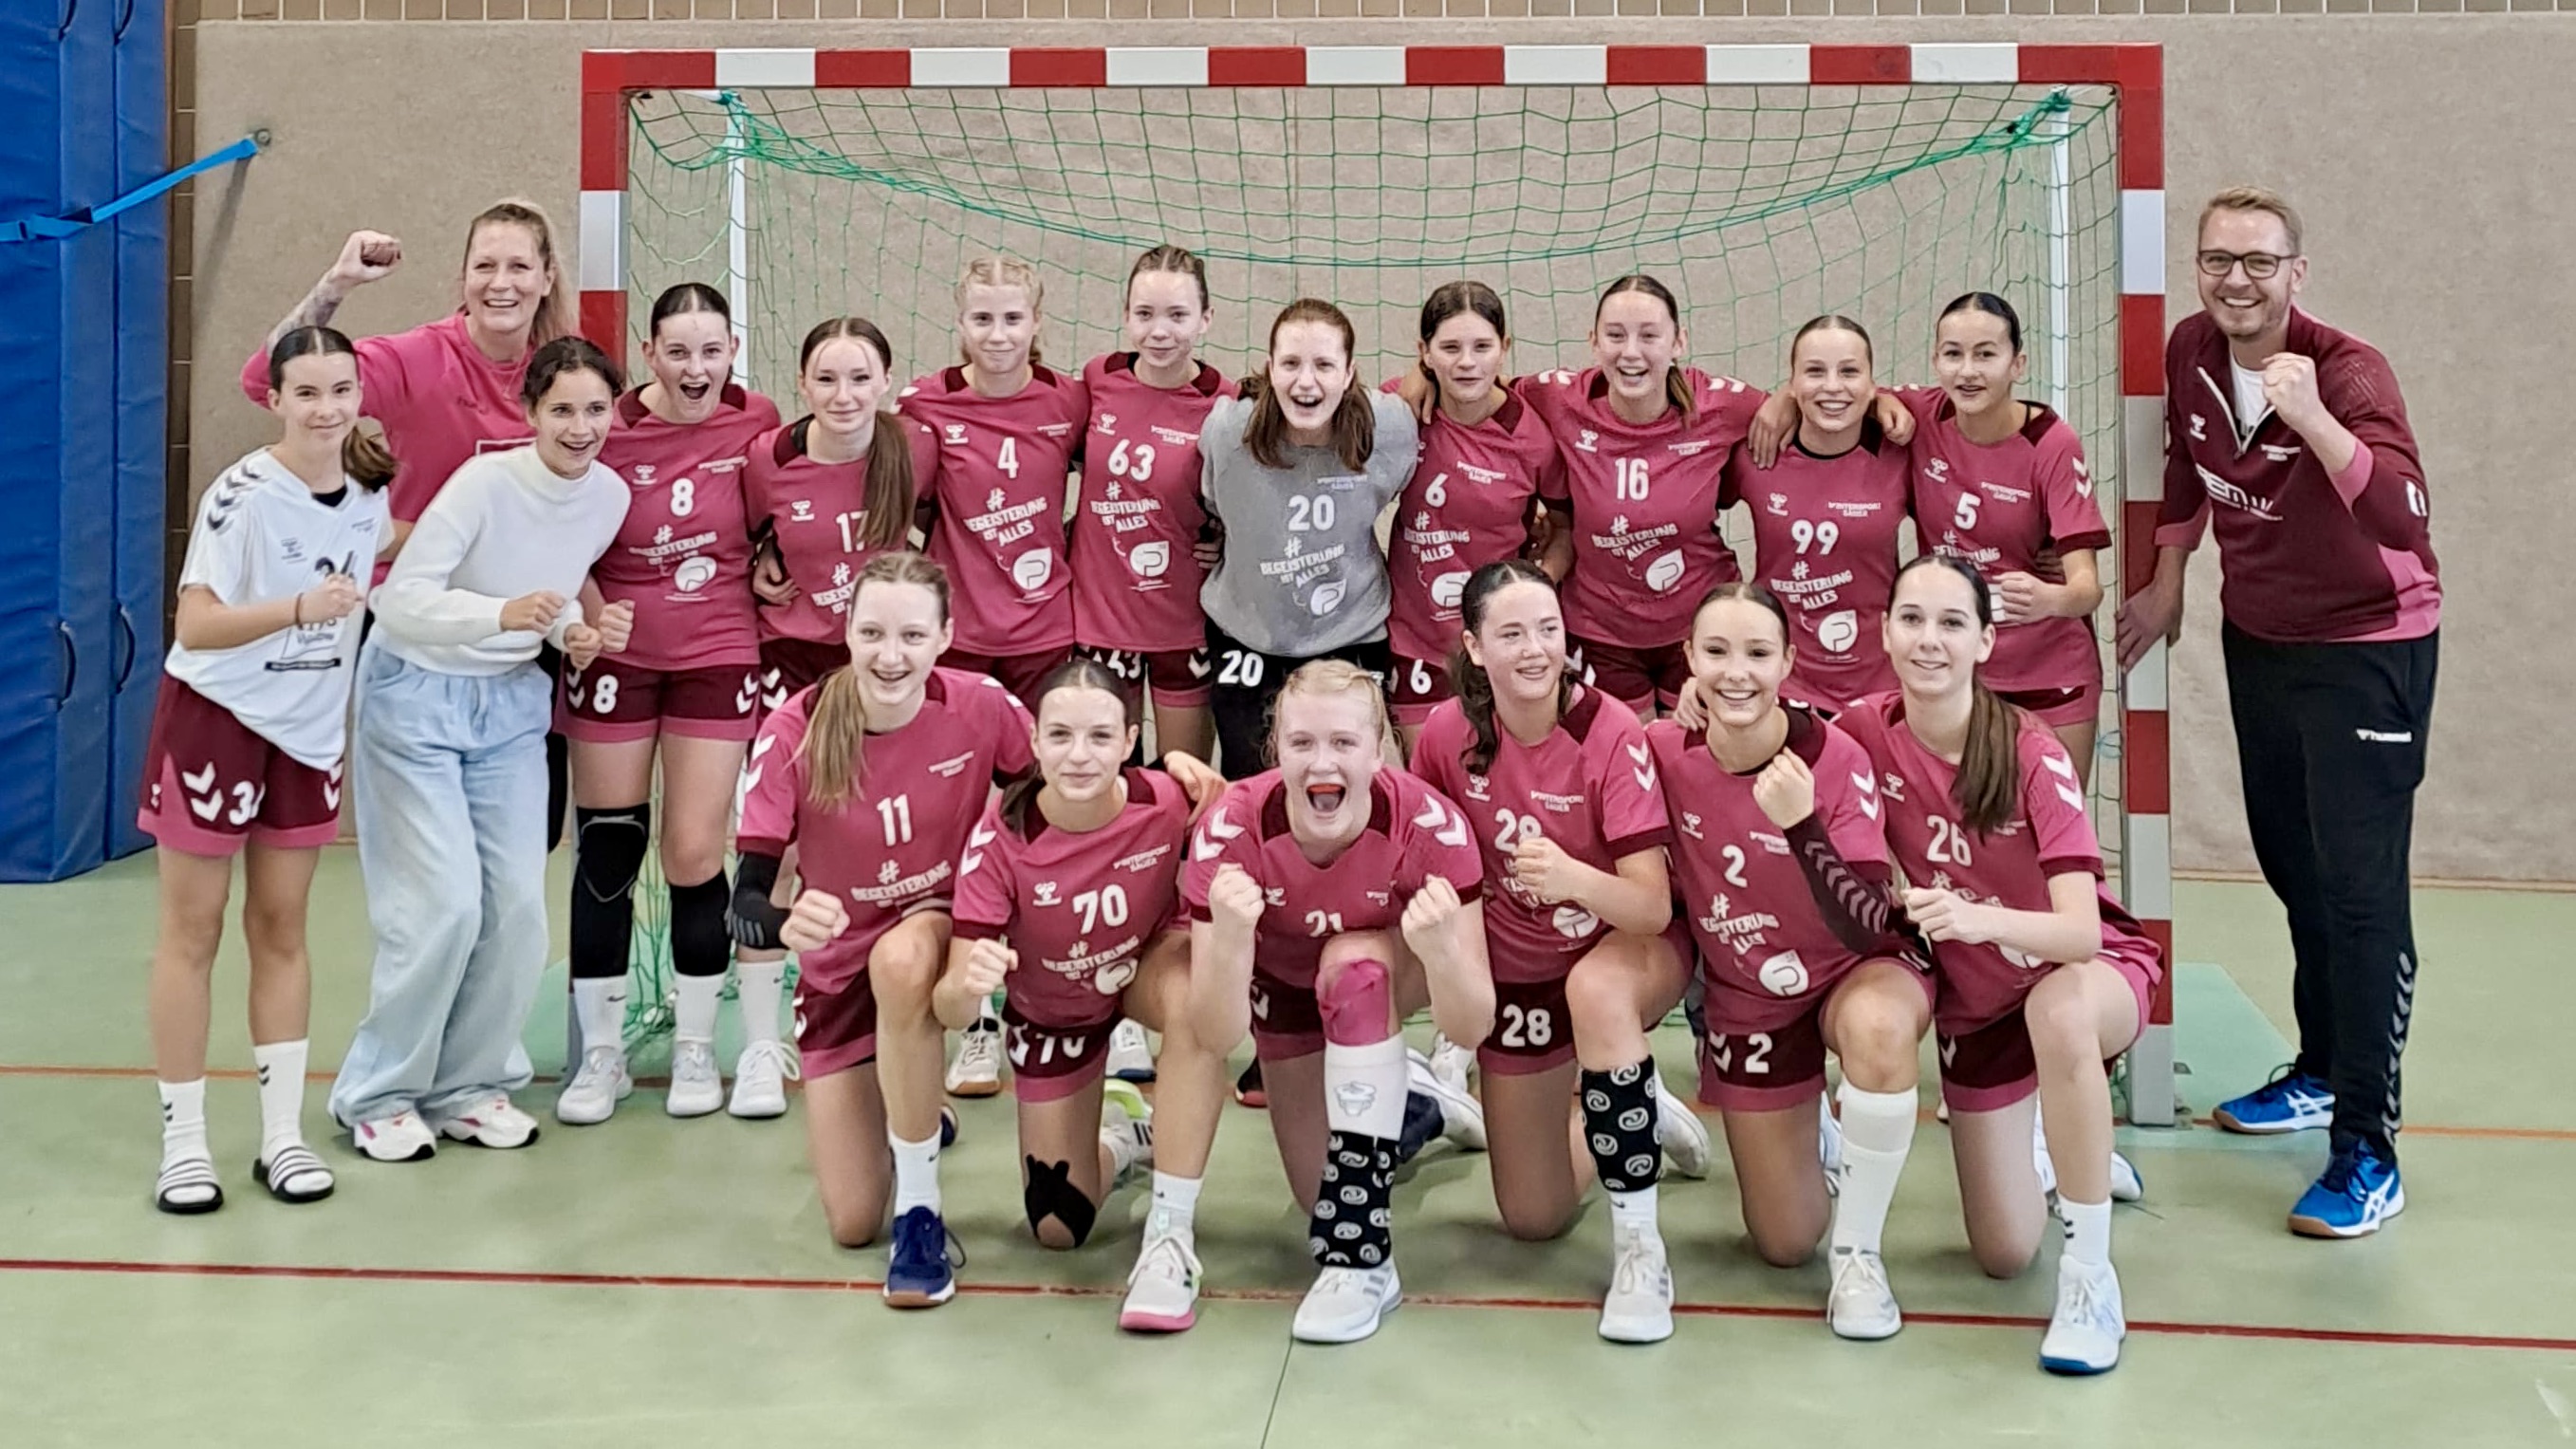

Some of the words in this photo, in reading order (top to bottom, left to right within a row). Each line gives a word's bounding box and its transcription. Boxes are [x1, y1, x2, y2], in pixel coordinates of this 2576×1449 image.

[998, 437, 1019, 478] 4
[1108, 439, 1156, 482] 63
[671, 478, 695, 517] 8
[1425, 474, 1448, 508] 6
[1615, 457, 1649, 501] 16
[1288, 494, 1335, 531] 20
[1954, 492, 1981, 529] 5
[835, 510, 870, 553] 17
[997, 519, 1034, 548] ALLES
[1791, 519, 1839, 555] 99
[1420, 543, 1455, 564] ALLES
[1295, 565, 1330, 589] ALLES
[1802, 589, 1839, 611] ALLES
[1218, 650, 1264, 687] 20
[1410, 659, 1433, 696] 6
[593, 674, 619, 714] 8
[877, 793, 912, 847] 11
[1927, 814, 1972, 867] 26
[1722, 845, 1748, 887] 2
[1072, 883, 1128, 935] 70
[1501, 1003, 1552, 1048] 28
[1745, 1032, 1772, 1073] 2
